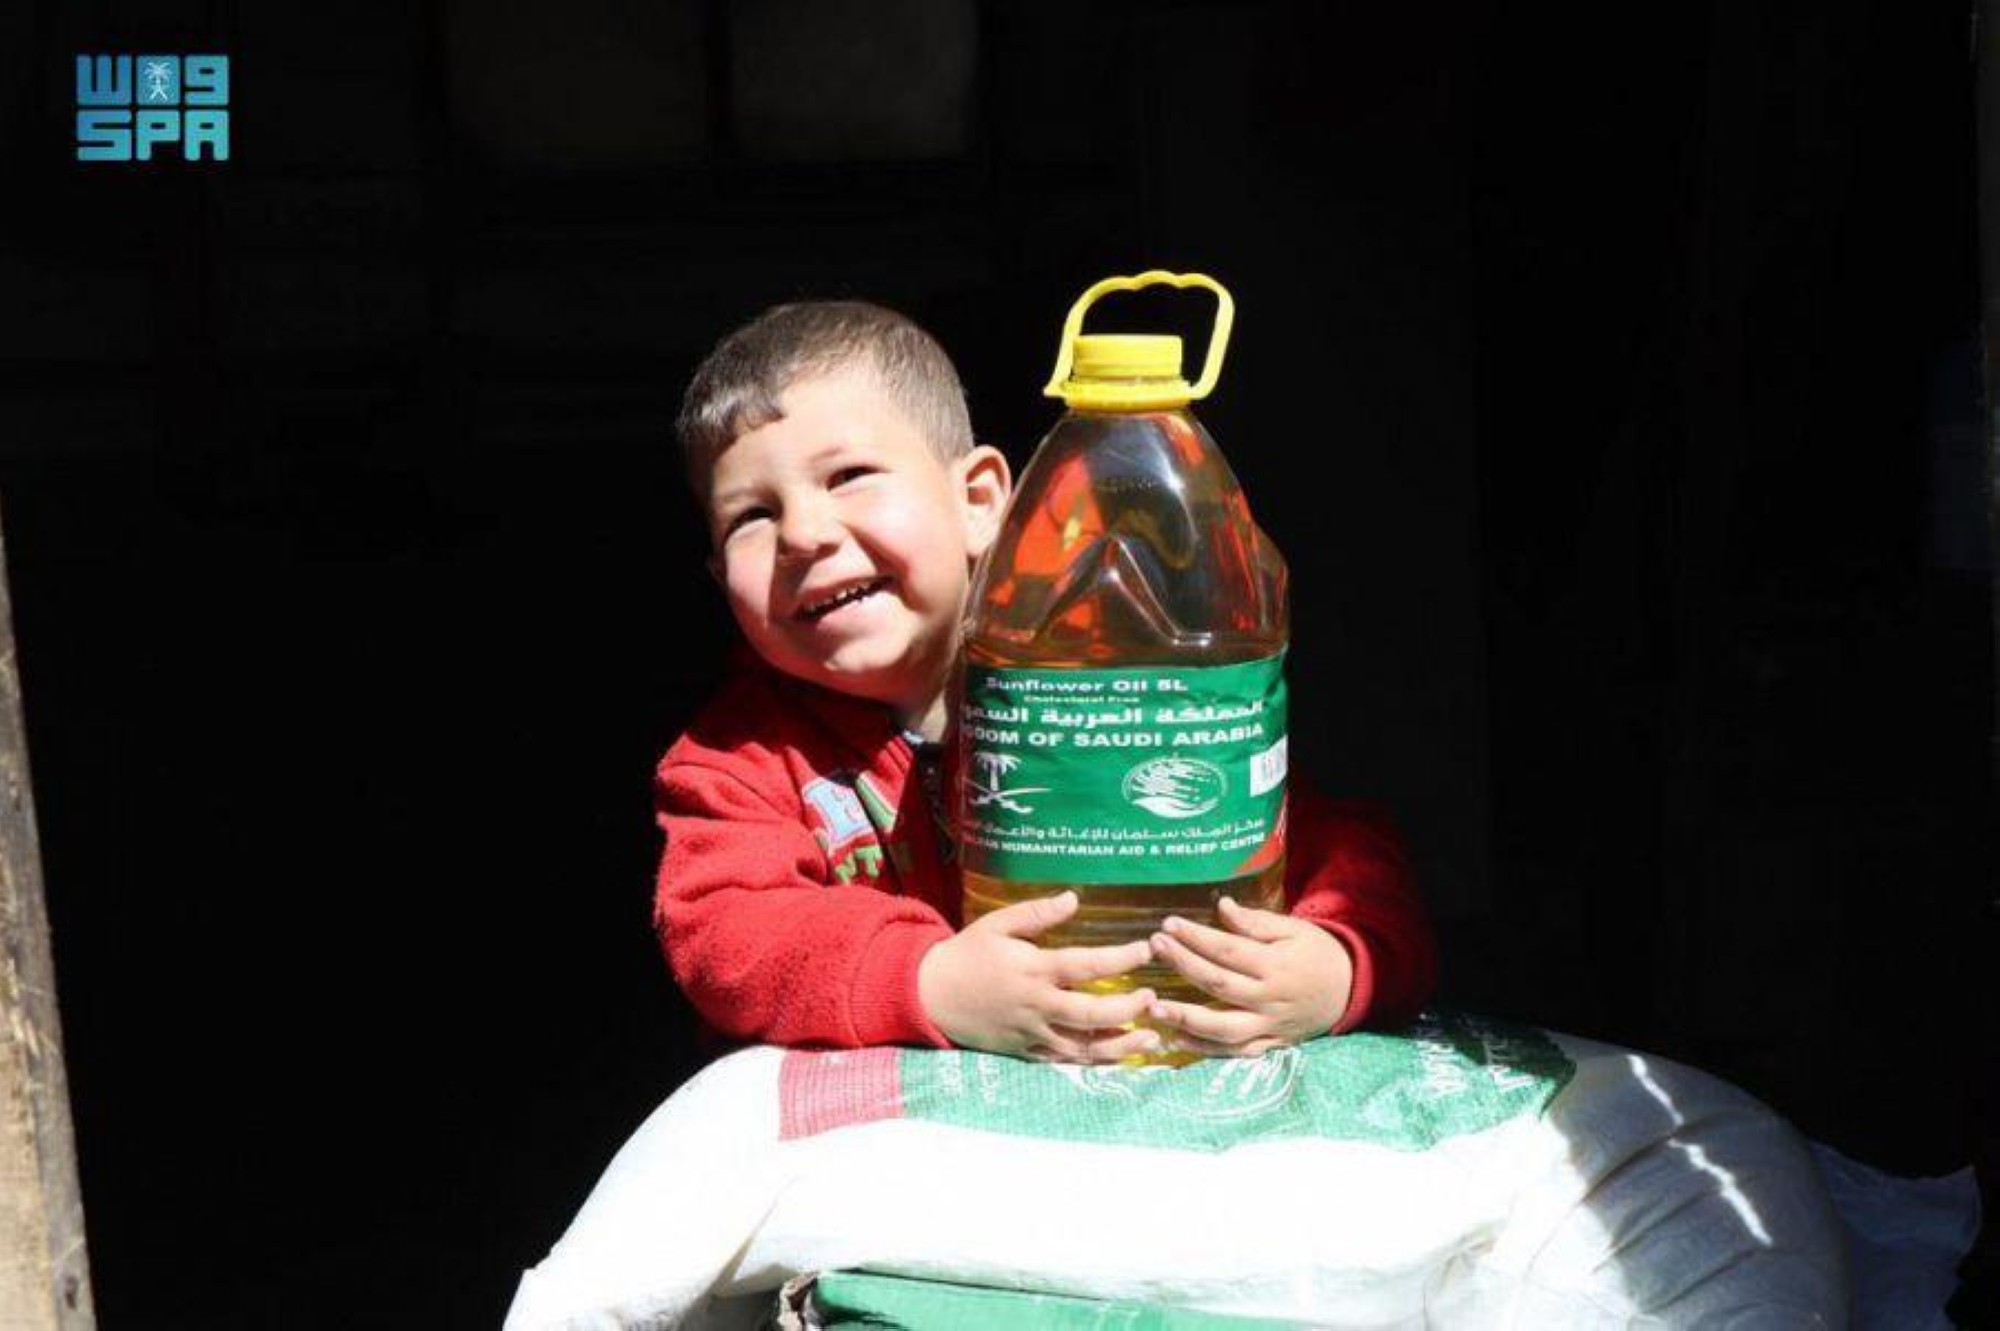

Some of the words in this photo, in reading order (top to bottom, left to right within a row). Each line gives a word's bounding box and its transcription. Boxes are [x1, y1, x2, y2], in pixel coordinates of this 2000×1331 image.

[986, 677, 1104, 692] Sunflower
[1112, 679, 1147, 691] Oil
[1157, 678, 1188, 691] 5L
[1040, 707, 1142, 729] العربية
[1155, 700, 1264, 722] المملكة
[1027, 731, 1065, 747] OF
[1073, 732, 1162, 748] SAUDI
[1172, 723, 1264, 746] ARABIA
[1000, 841, 1113, 855] HUMANITARIAN
[1118, 844, 1145, 855] AID
[1165, 842, 1217, 855] RELIEF
